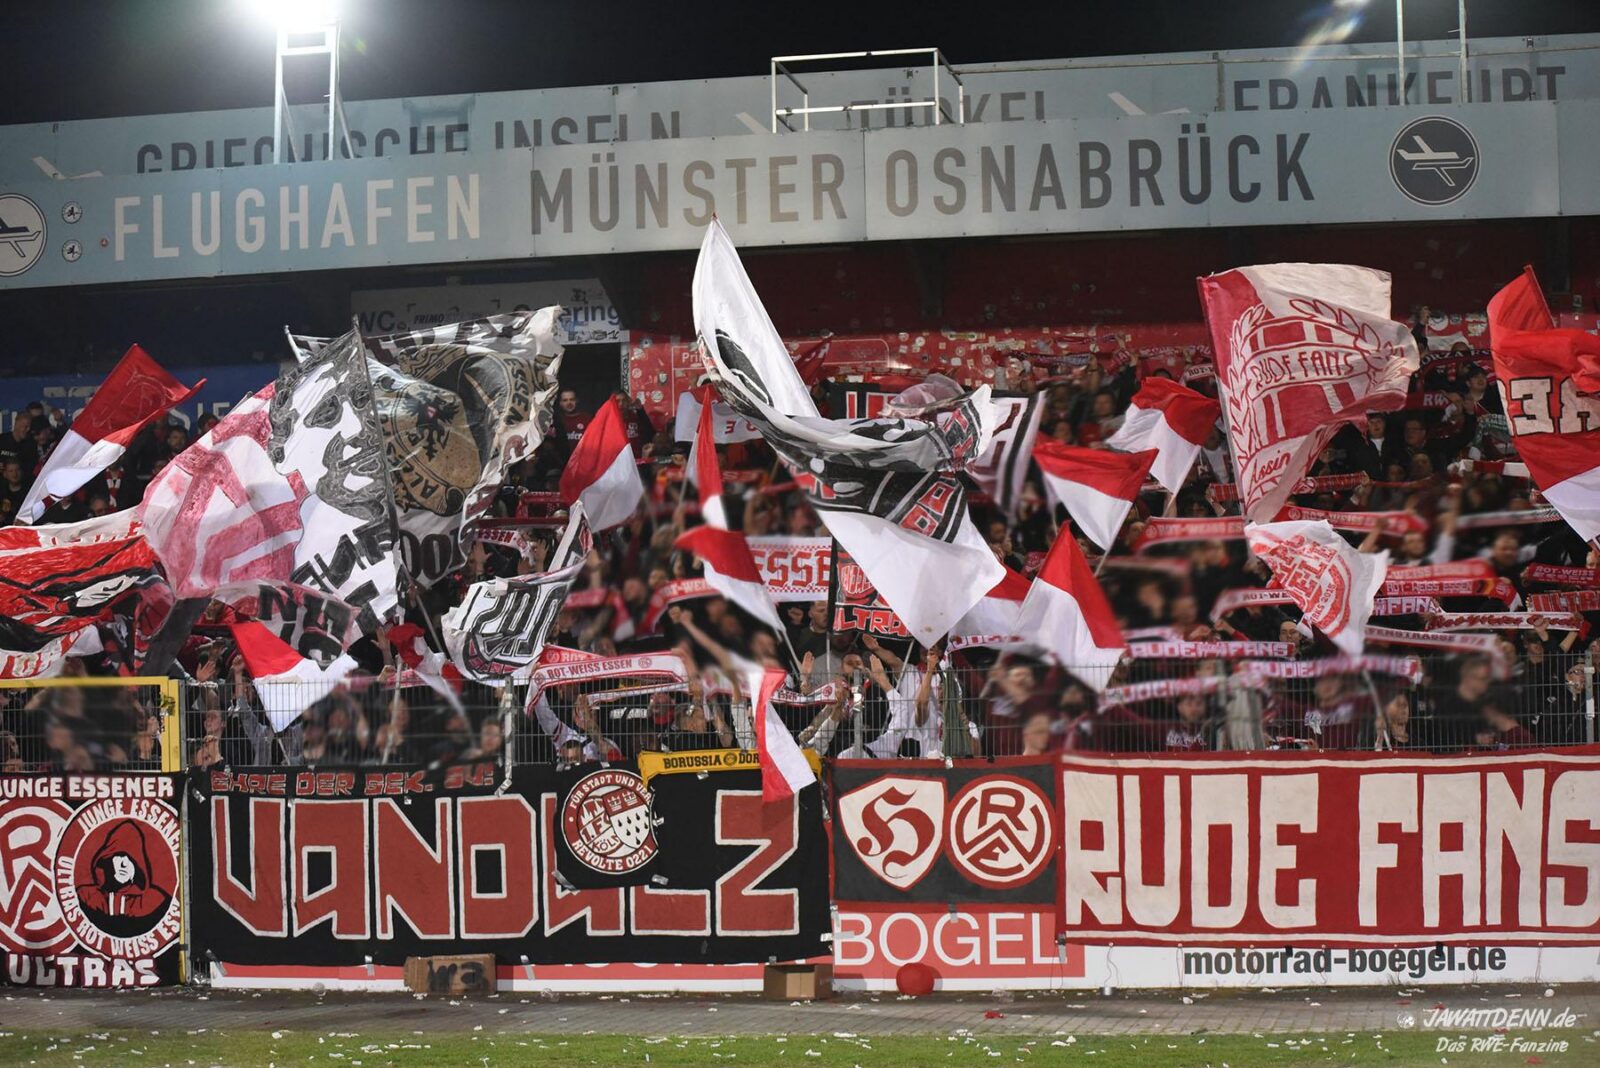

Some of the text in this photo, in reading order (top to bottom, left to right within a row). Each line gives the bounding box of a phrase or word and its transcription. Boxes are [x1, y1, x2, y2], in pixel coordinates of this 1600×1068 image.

[114, 122, 1315, 261] FLUGHAFEN MÜNSTER OSNABRÜCK
[1251, 350, 1355, 391] RUDE FANS
[547, 657, 633, 680] ROT-WEISS ESSEN
[663, 755, 722, 769] BORUSSIA
[68, 776, 174, 798] ESSENER
[210, 769, 287, 795] EHRE
[295, 772, 356, 795] DER
[582, 774, 614, 793] STADT
[614, 774, 635, 788] UND
[77, 799, 125, 834] JUNGE
[571, 838, 654, 871] REVOLTE 0221
[1063, 767, 1600, 930] RUDE FANS
[77, 920, 106, 950] ROT
[110, 933, 160, 959] WEISS
[8, 953, 161, 986] ULTRAS
[1183, 944, 1508, 979] motorrad-boegel.de
